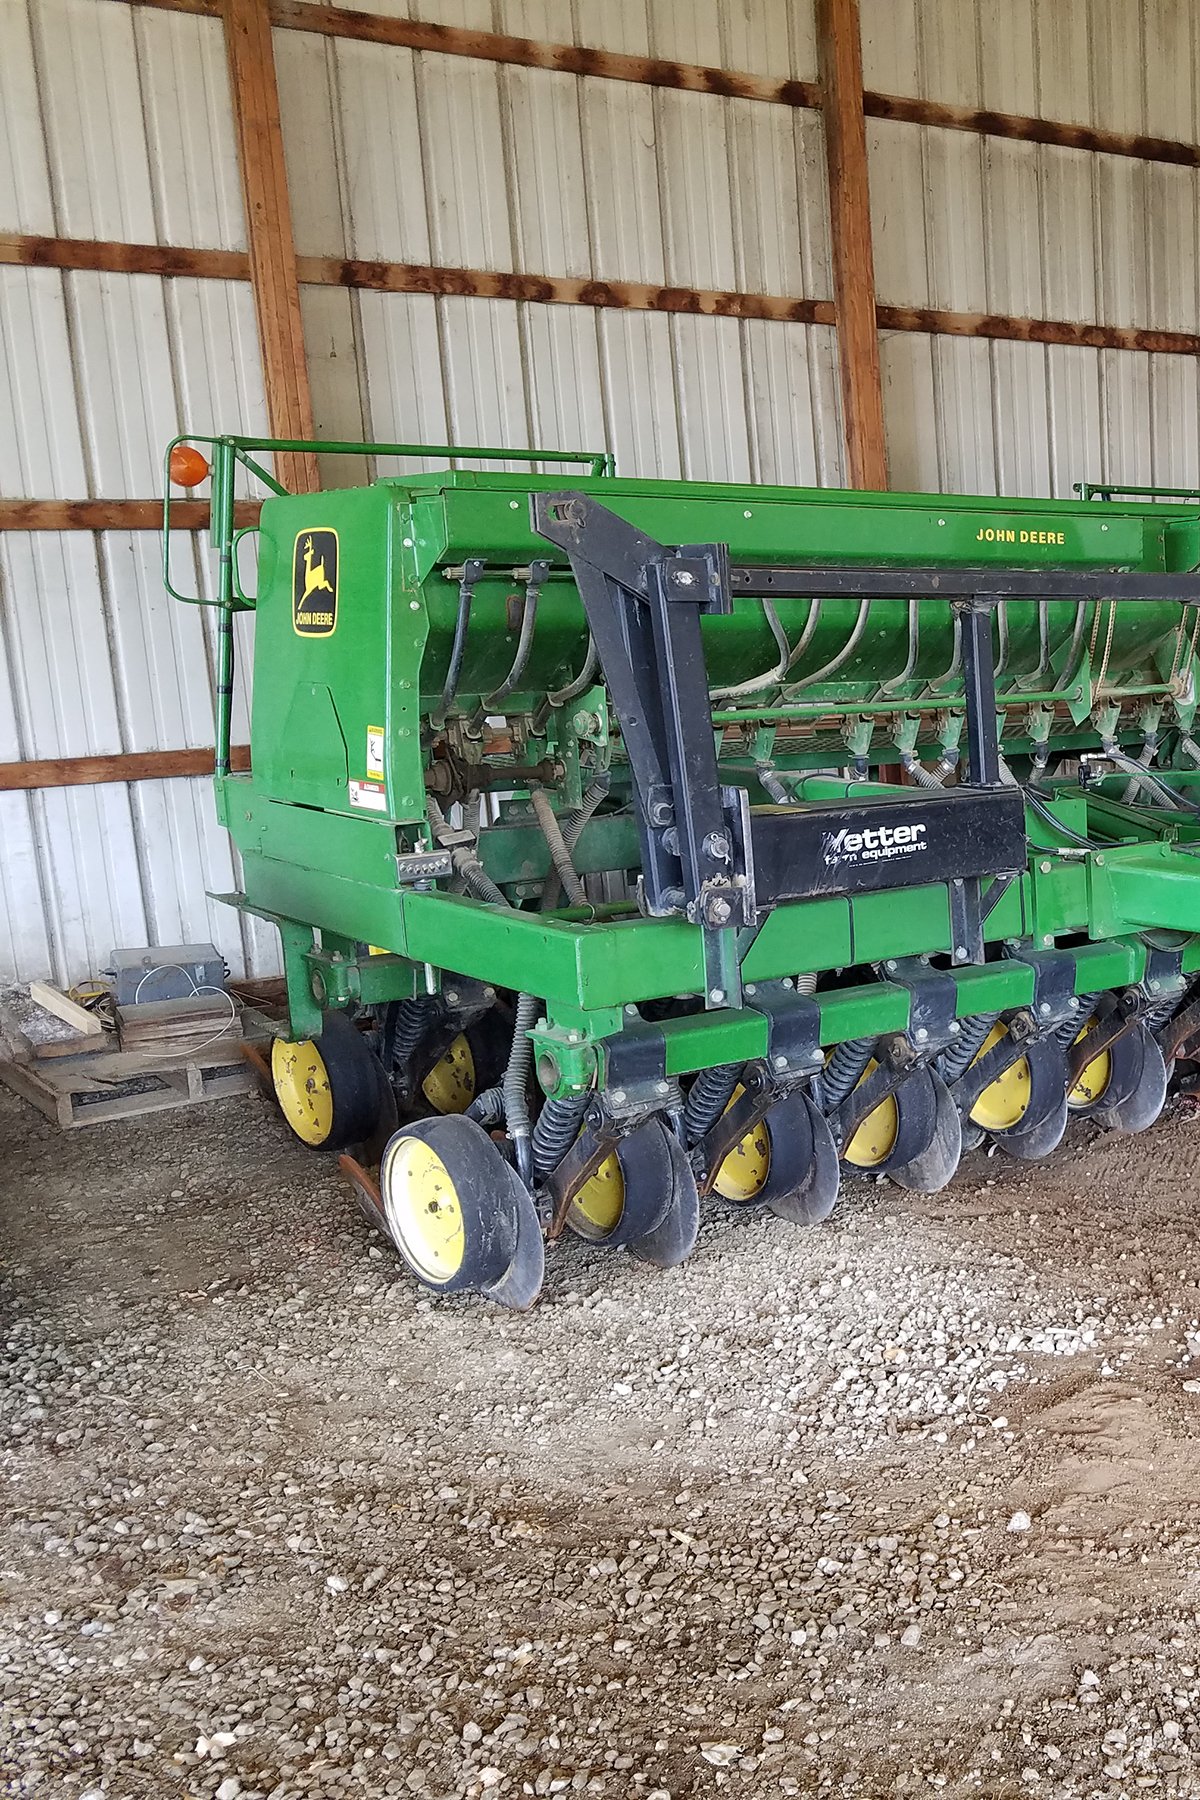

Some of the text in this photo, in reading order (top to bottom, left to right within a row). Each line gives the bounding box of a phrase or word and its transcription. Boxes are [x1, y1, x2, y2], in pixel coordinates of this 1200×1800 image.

[976, 528, 1065, 545] JOHN DEERE
[296, 612, 333, 626] JOHN DEERE
[861, 841, 928, 861] equipment
